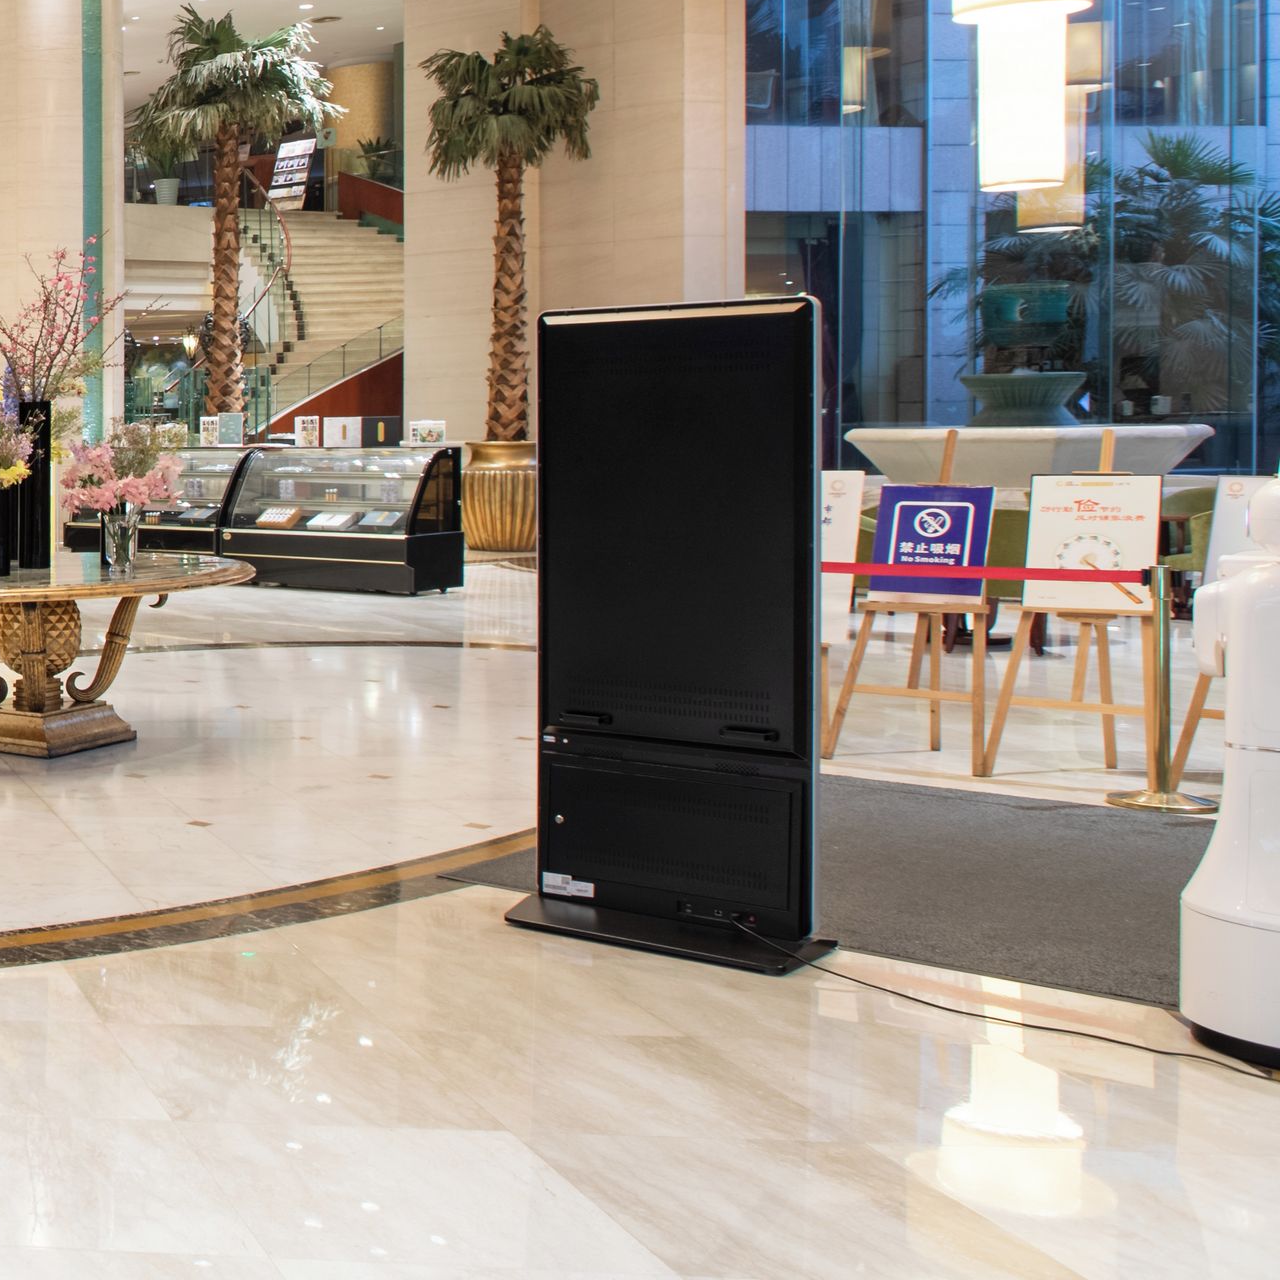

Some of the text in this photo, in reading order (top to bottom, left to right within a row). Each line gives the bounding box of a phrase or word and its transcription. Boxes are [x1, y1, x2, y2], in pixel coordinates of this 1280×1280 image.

[899, 542, 961, 555] 禁止吸烟
[914, 556, 956, 565] Smoking
